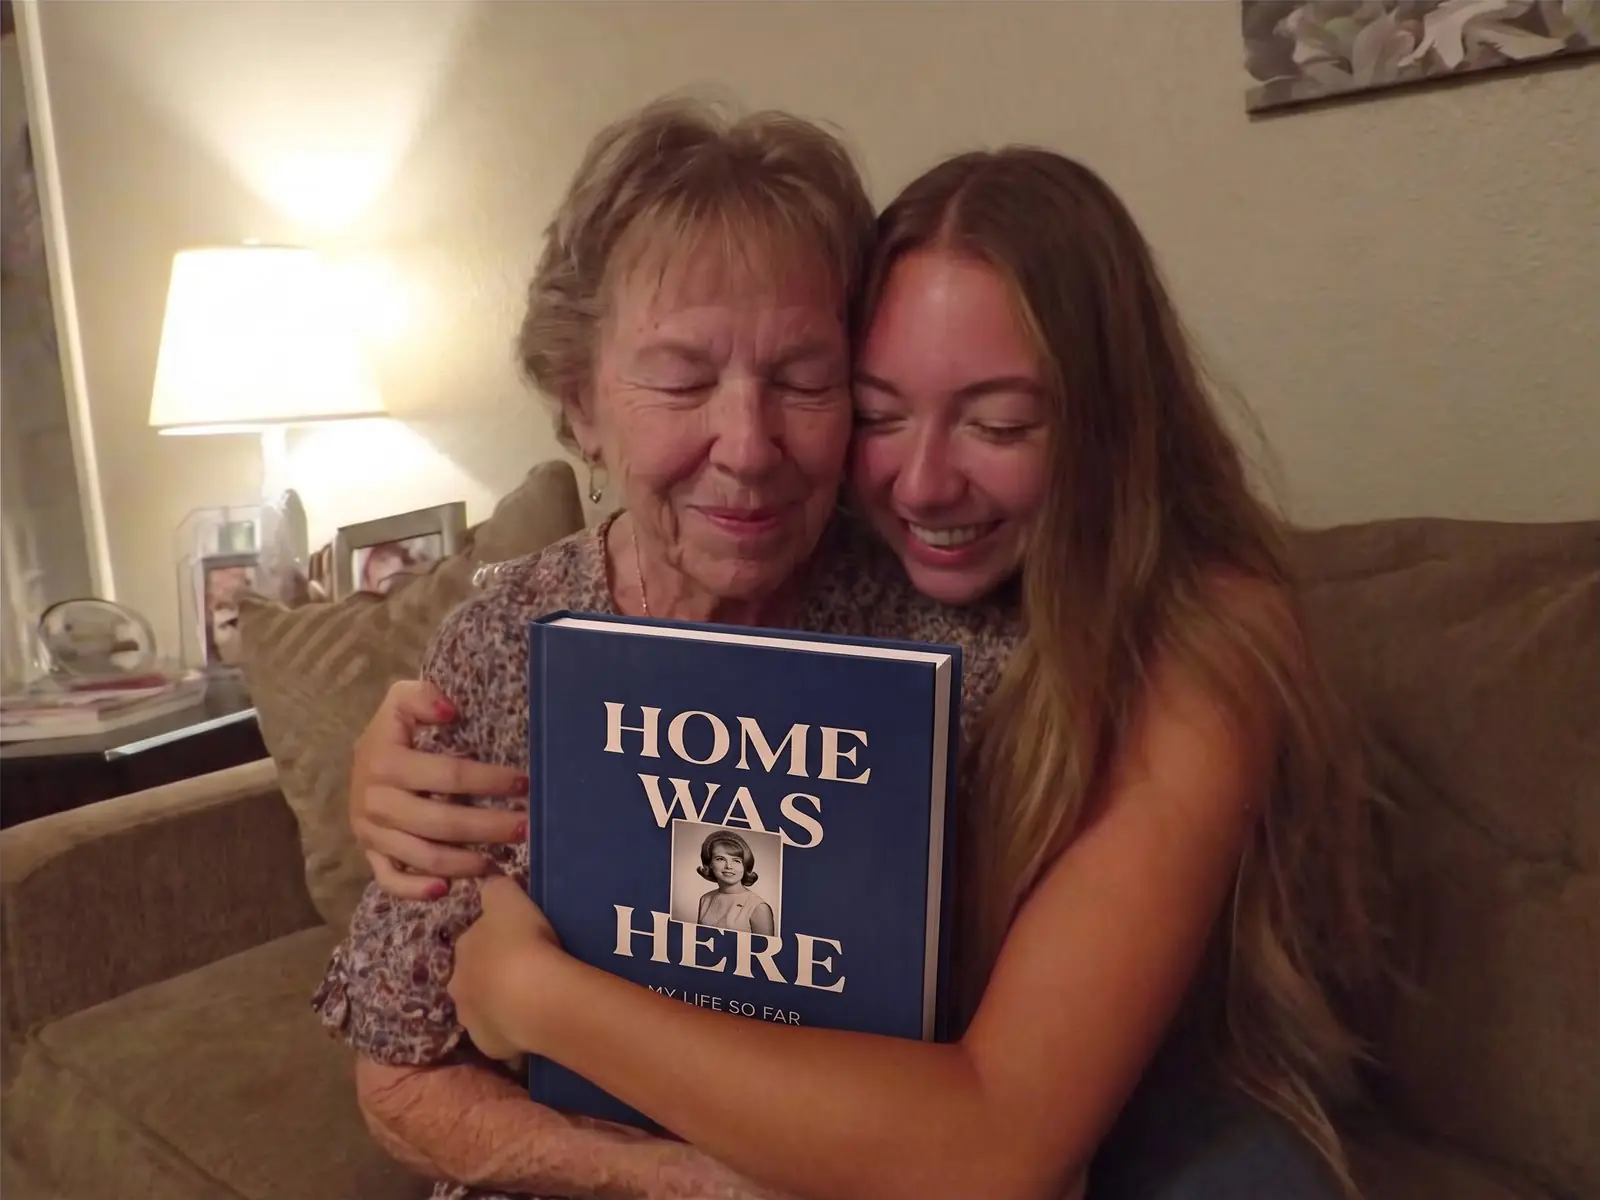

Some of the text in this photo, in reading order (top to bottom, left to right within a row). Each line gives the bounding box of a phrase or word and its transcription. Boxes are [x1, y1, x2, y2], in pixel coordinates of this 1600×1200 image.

[603, 701, 871, 784] HOME
[637, 773, 824, 848] WAS
[613, 904, 847, 993] HERE
[683, 991, 722, 1011] LIFE
[728, 1000, 756, 1017] SO
[763, 1006, 801, 1026] FAR
